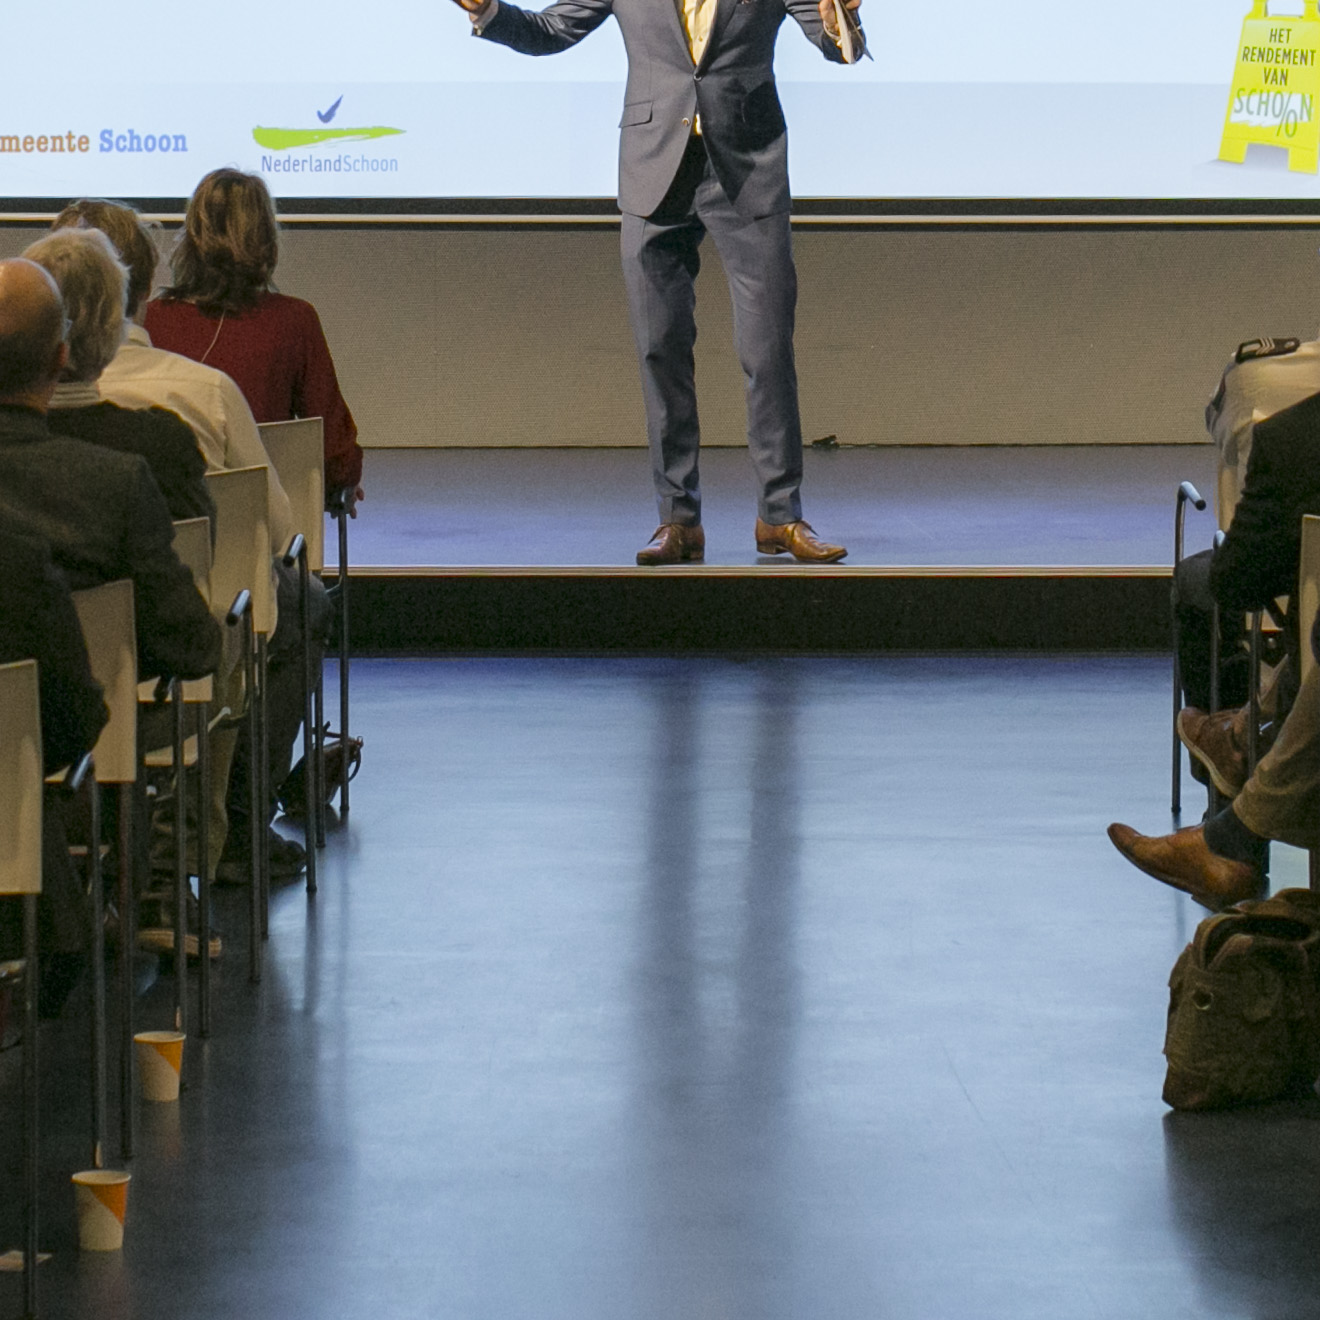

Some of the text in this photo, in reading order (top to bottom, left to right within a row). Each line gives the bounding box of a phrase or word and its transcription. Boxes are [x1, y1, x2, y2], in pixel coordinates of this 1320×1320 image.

[1269, 28, 1292, 43] HET
[1242, 46, 1316, 66] RENDEMENT
[1263, 68, 1288, 86] VAN
[98, 128, 189, 154] Schoon
[260, 154, 399, 174] NederlandSchoon
